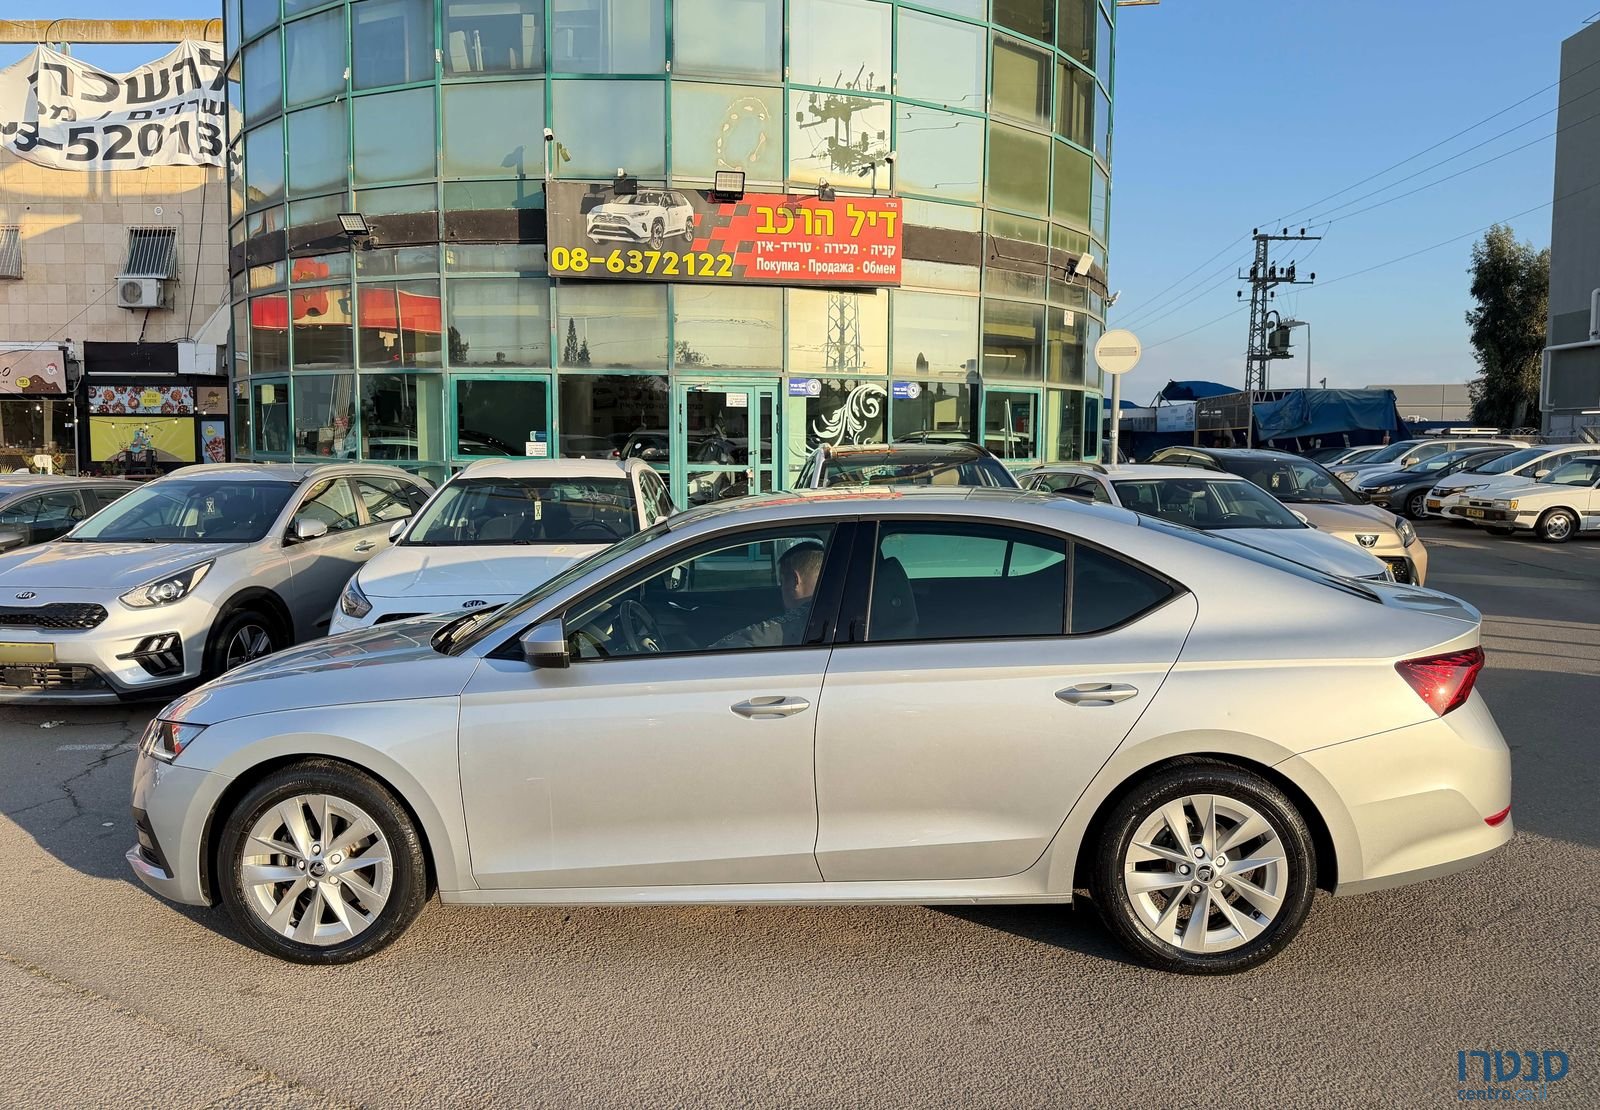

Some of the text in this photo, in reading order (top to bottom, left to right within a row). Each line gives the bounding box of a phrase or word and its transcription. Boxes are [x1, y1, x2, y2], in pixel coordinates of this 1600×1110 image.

[755, 203, 898, 239] דיל הרכב
[756, 240, 896, 258] קניה מכירה טרייד-אין
[550, 246, 733, 277] 08-6372122
[756, 257, 897, 275] Покупка Продажа Обмен
